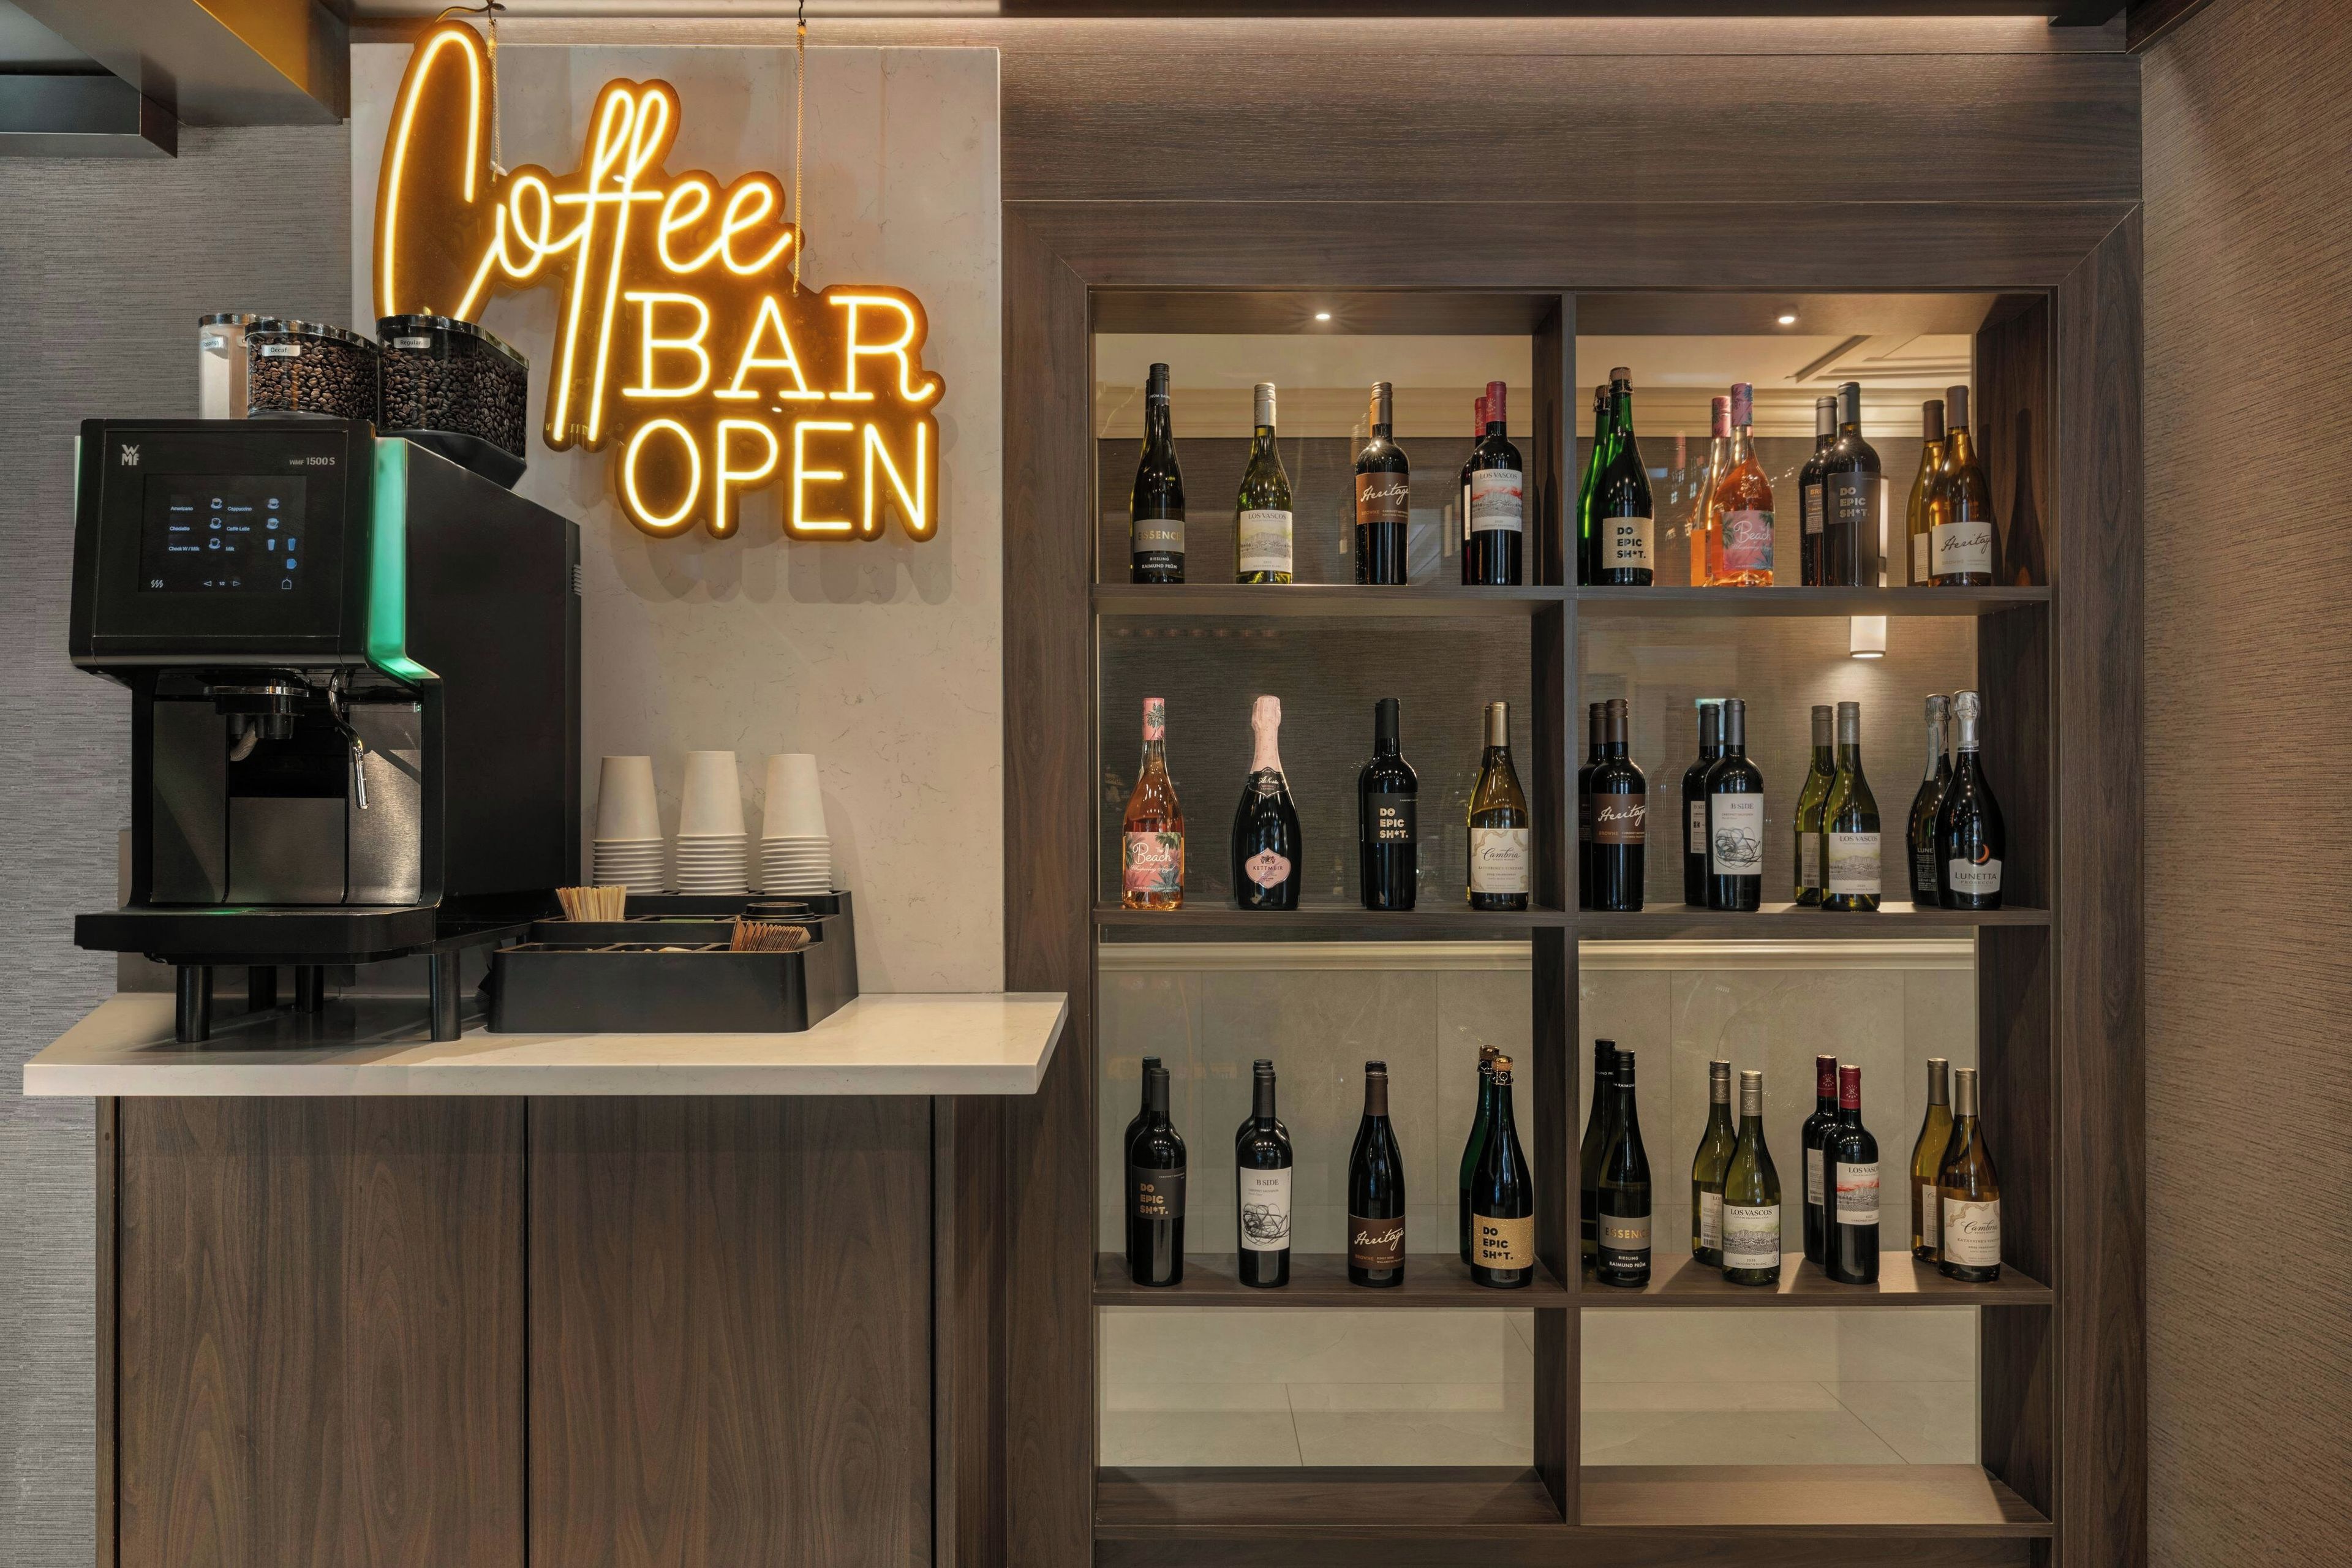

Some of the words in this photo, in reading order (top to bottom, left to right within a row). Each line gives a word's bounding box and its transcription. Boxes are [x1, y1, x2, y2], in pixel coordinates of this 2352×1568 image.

[385, 29, 794, 442] Coffee
[621, 292, 937, 402] BAR
[623, 418, 926, 532] OPEN
[1839, 487, 1856, 496] DO
[1839, 497, 1866, 507] EPIC
[1617, 527, 1634, 535] DO
[1379, 808, 1396, 816] DO
[1379, 819, 1405, 827] EPIC
[1133, 842, 1171, 865] Beach
[1481, 847, 1520, 861] Cambria
[1140, 1183, 1155, 1193] DO
[1140, 1194, 1164, 1204] EPIC
[1483, 1226, 1498, 1236] DO
[1354, 1227, 1404, 1251] Heritage
[1483, 1238, 1509, 1248] EPIC
